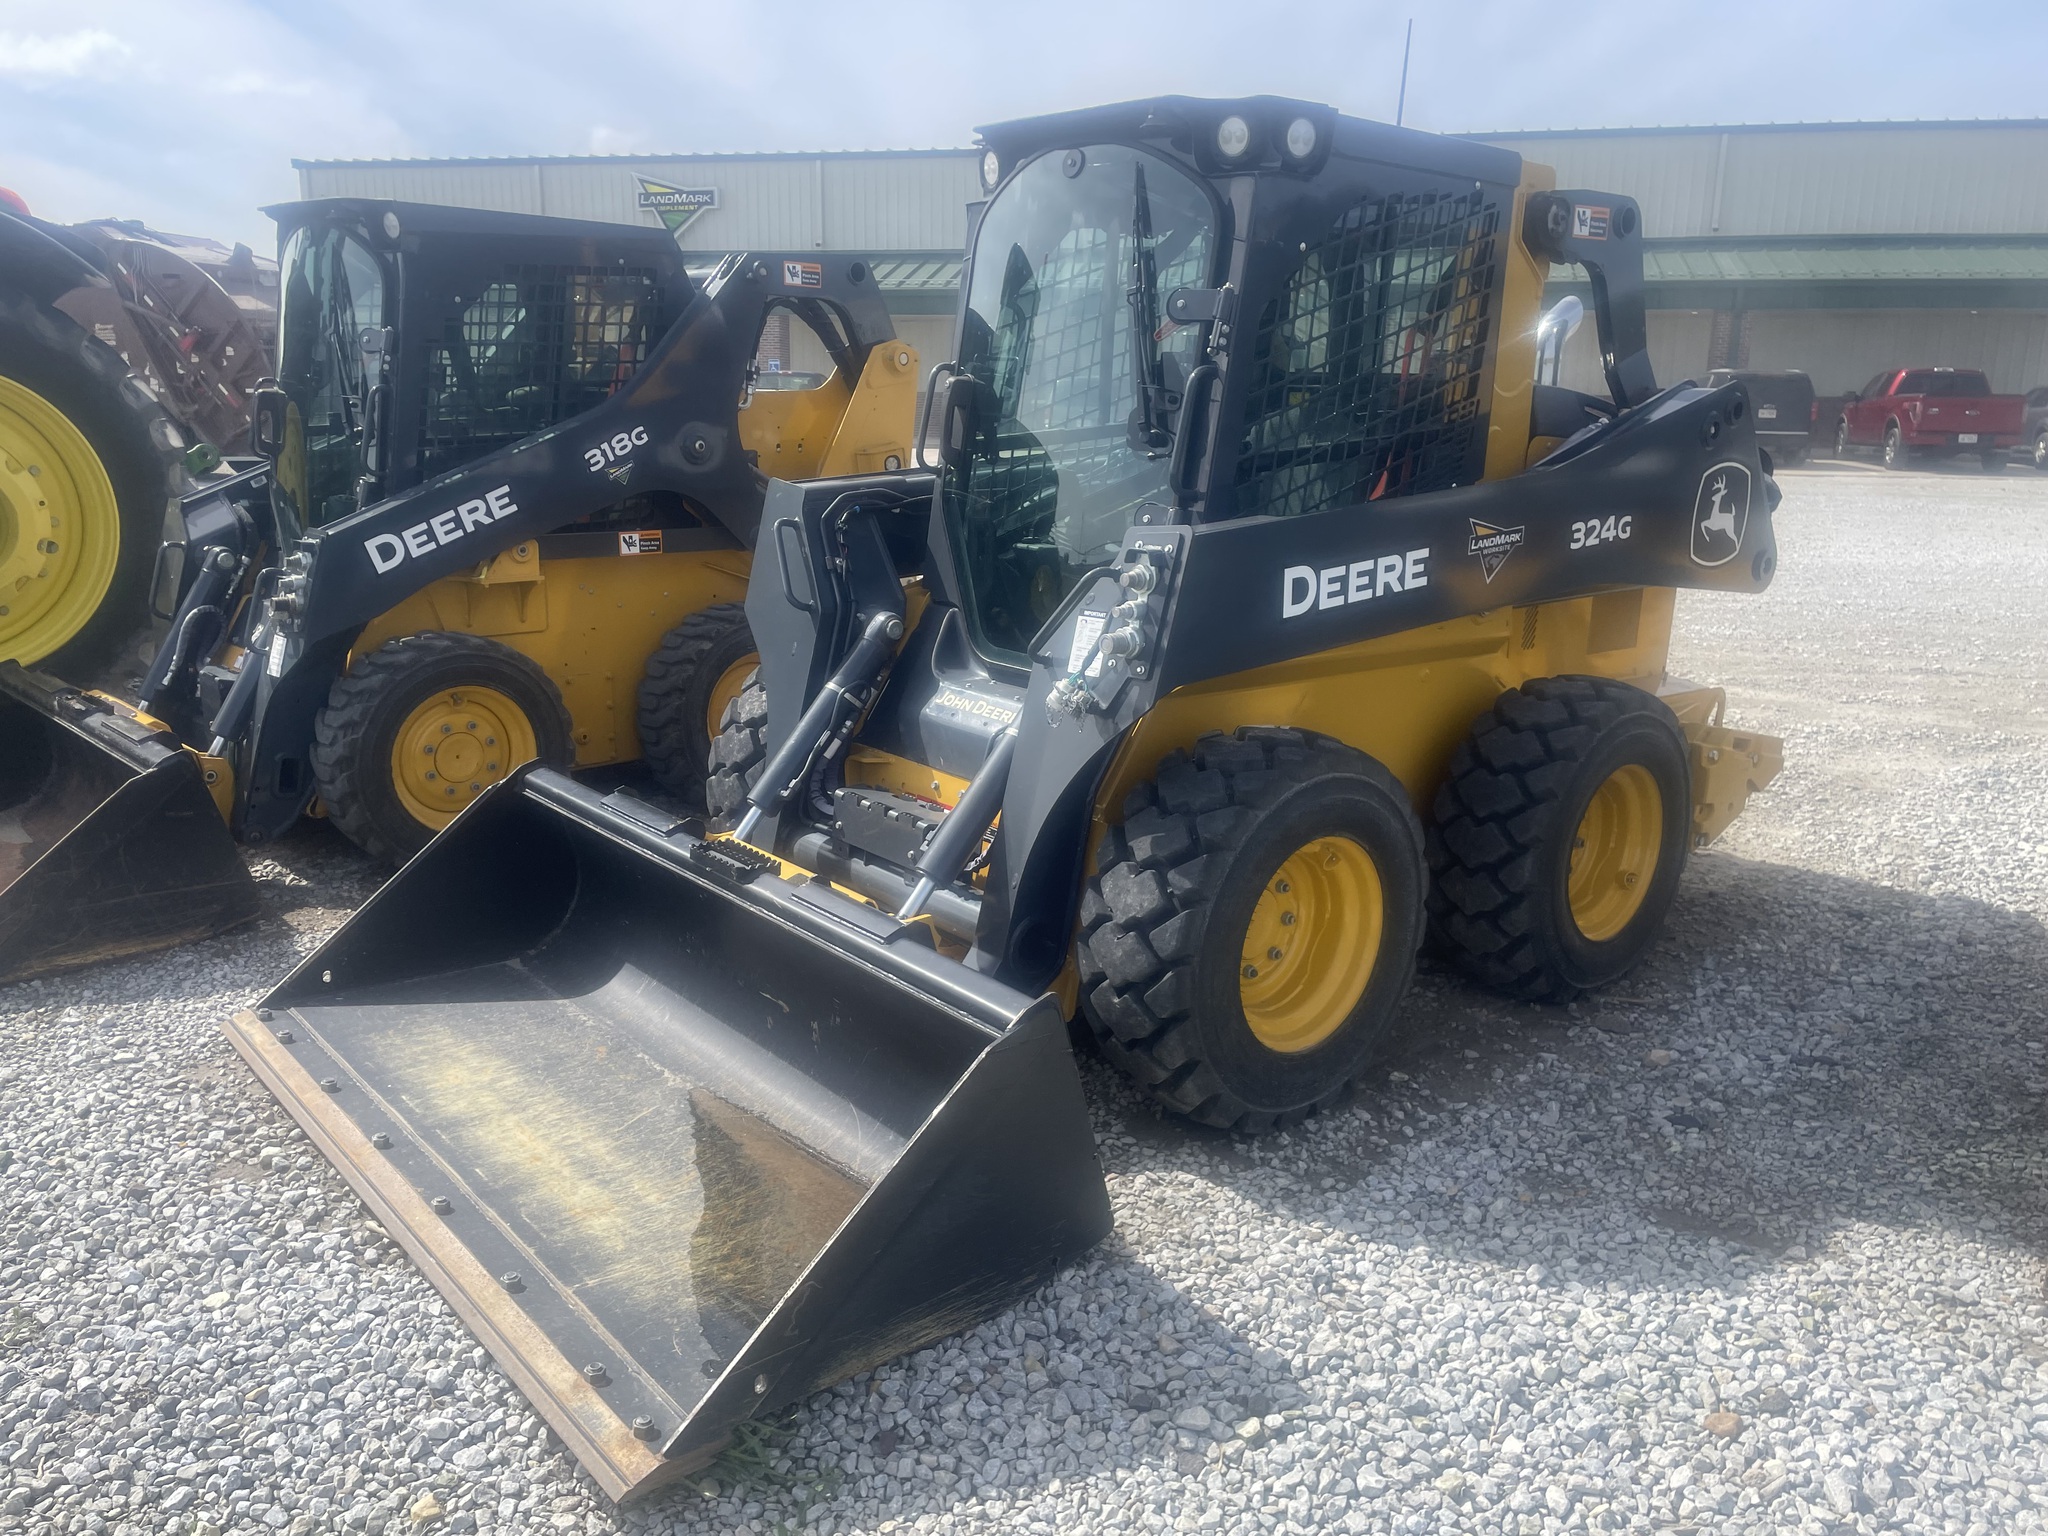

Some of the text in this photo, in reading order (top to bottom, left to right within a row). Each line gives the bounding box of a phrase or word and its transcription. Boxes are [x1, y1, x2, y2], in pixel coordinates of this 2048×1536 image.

[640, 194, 712, 204] LANDMARK
[584, 426, 649, 472] 318G
[364, 484, 518, 575] DEERE
[1570, 515, 1632, 550] 324G
[1471, 532, 1522, 550] LANDMARK
[1482, 544, 1511, 555] WORKSITE
[1283, 548, 1430, 619] DEERE
[1083, 610, 1107, 618] IMPORTANT
[936, 691, 974, 712] JOHN
